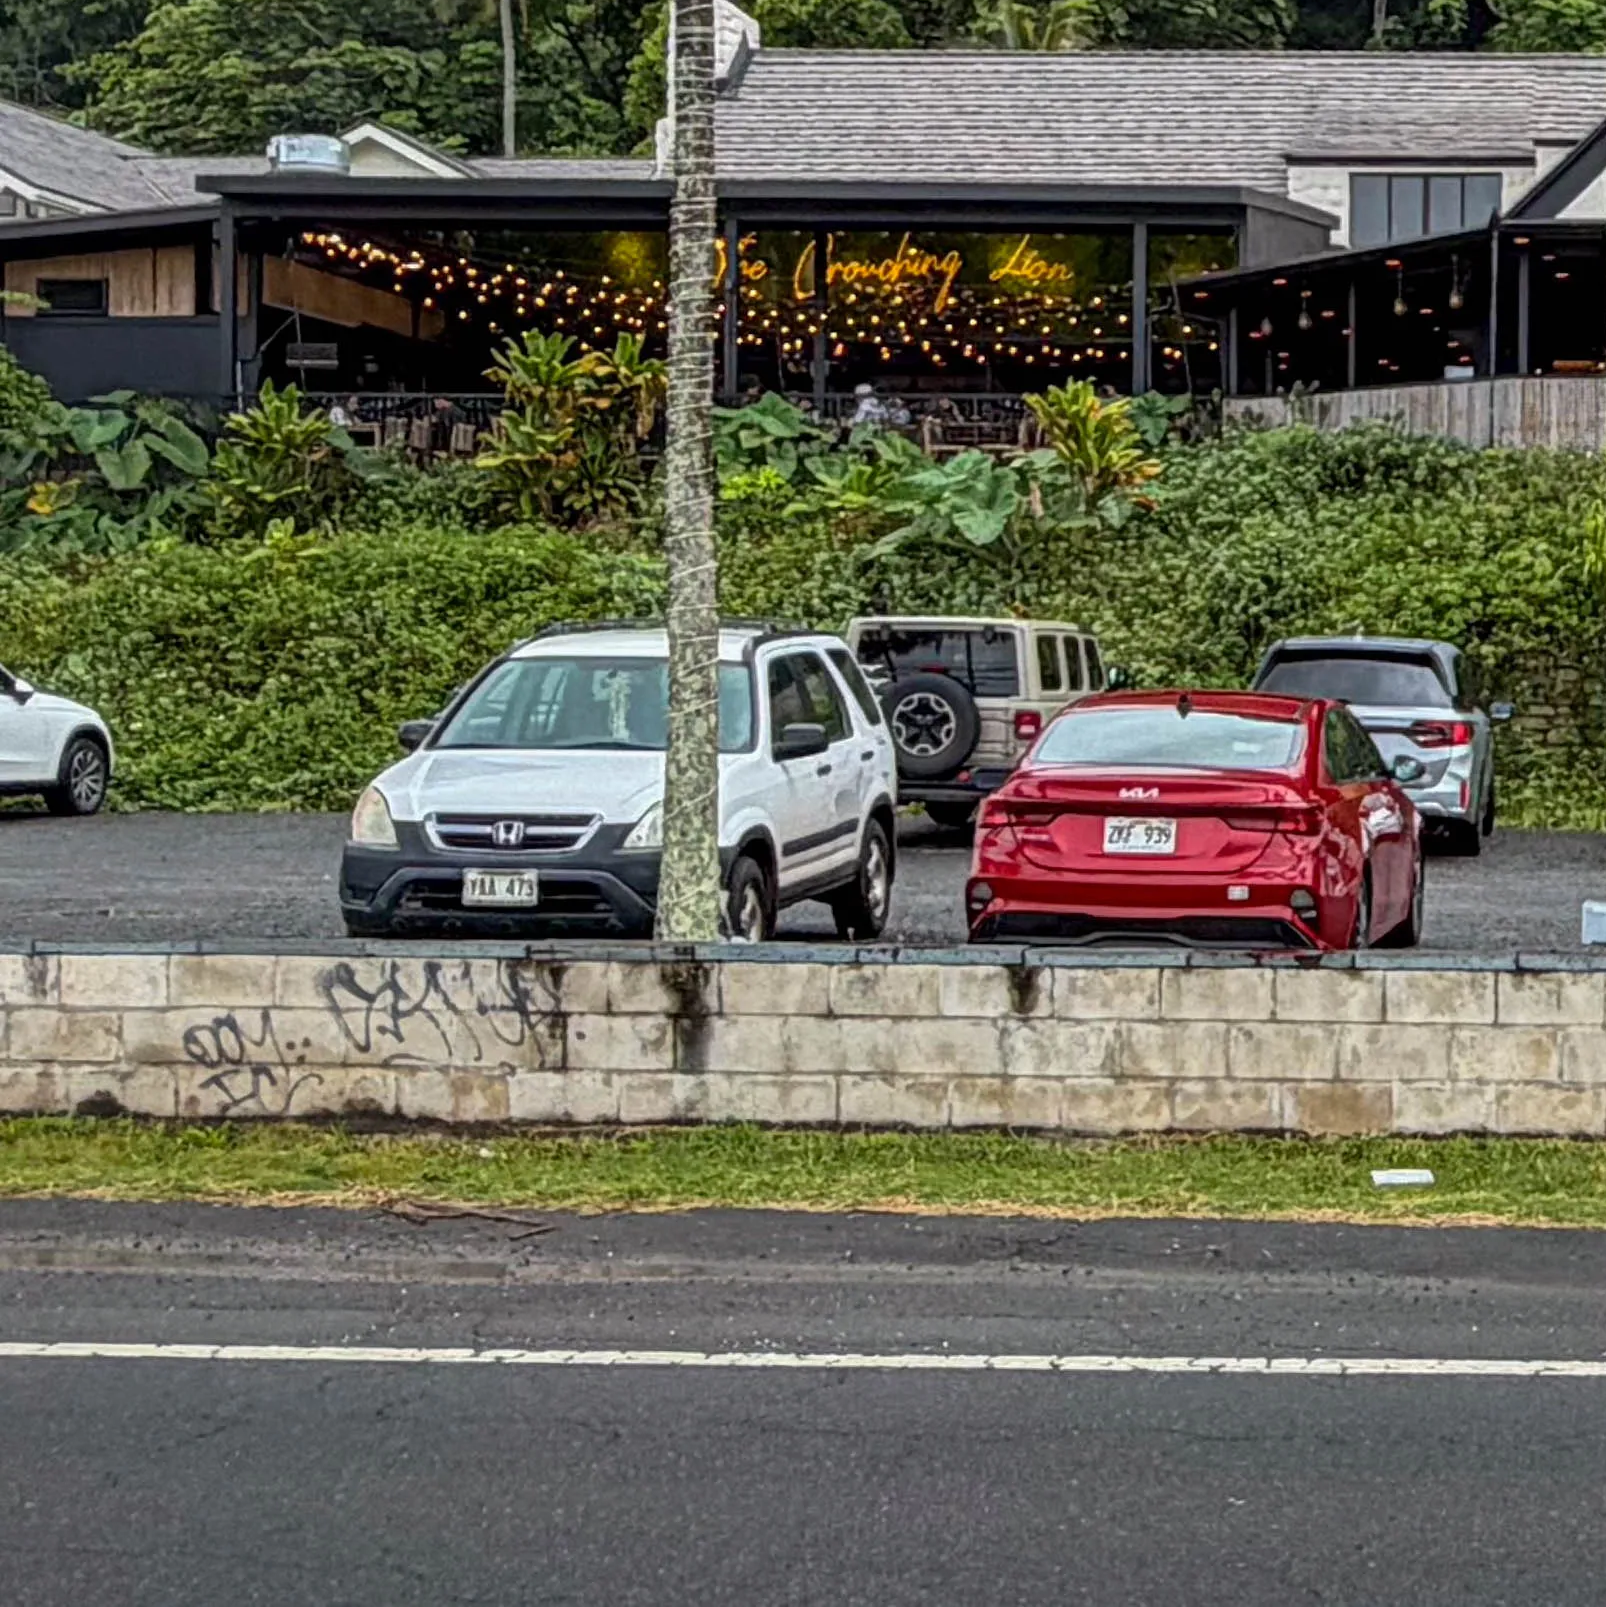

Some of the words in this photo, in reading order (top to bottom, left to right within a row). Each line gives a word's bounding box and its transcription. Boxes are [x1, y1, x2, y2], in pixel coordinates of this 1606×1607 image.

[793, 231, 962, 315] Crouching
[988, 233, 1075, 281] Lion
[1144, 825, 1172, 844] 939
